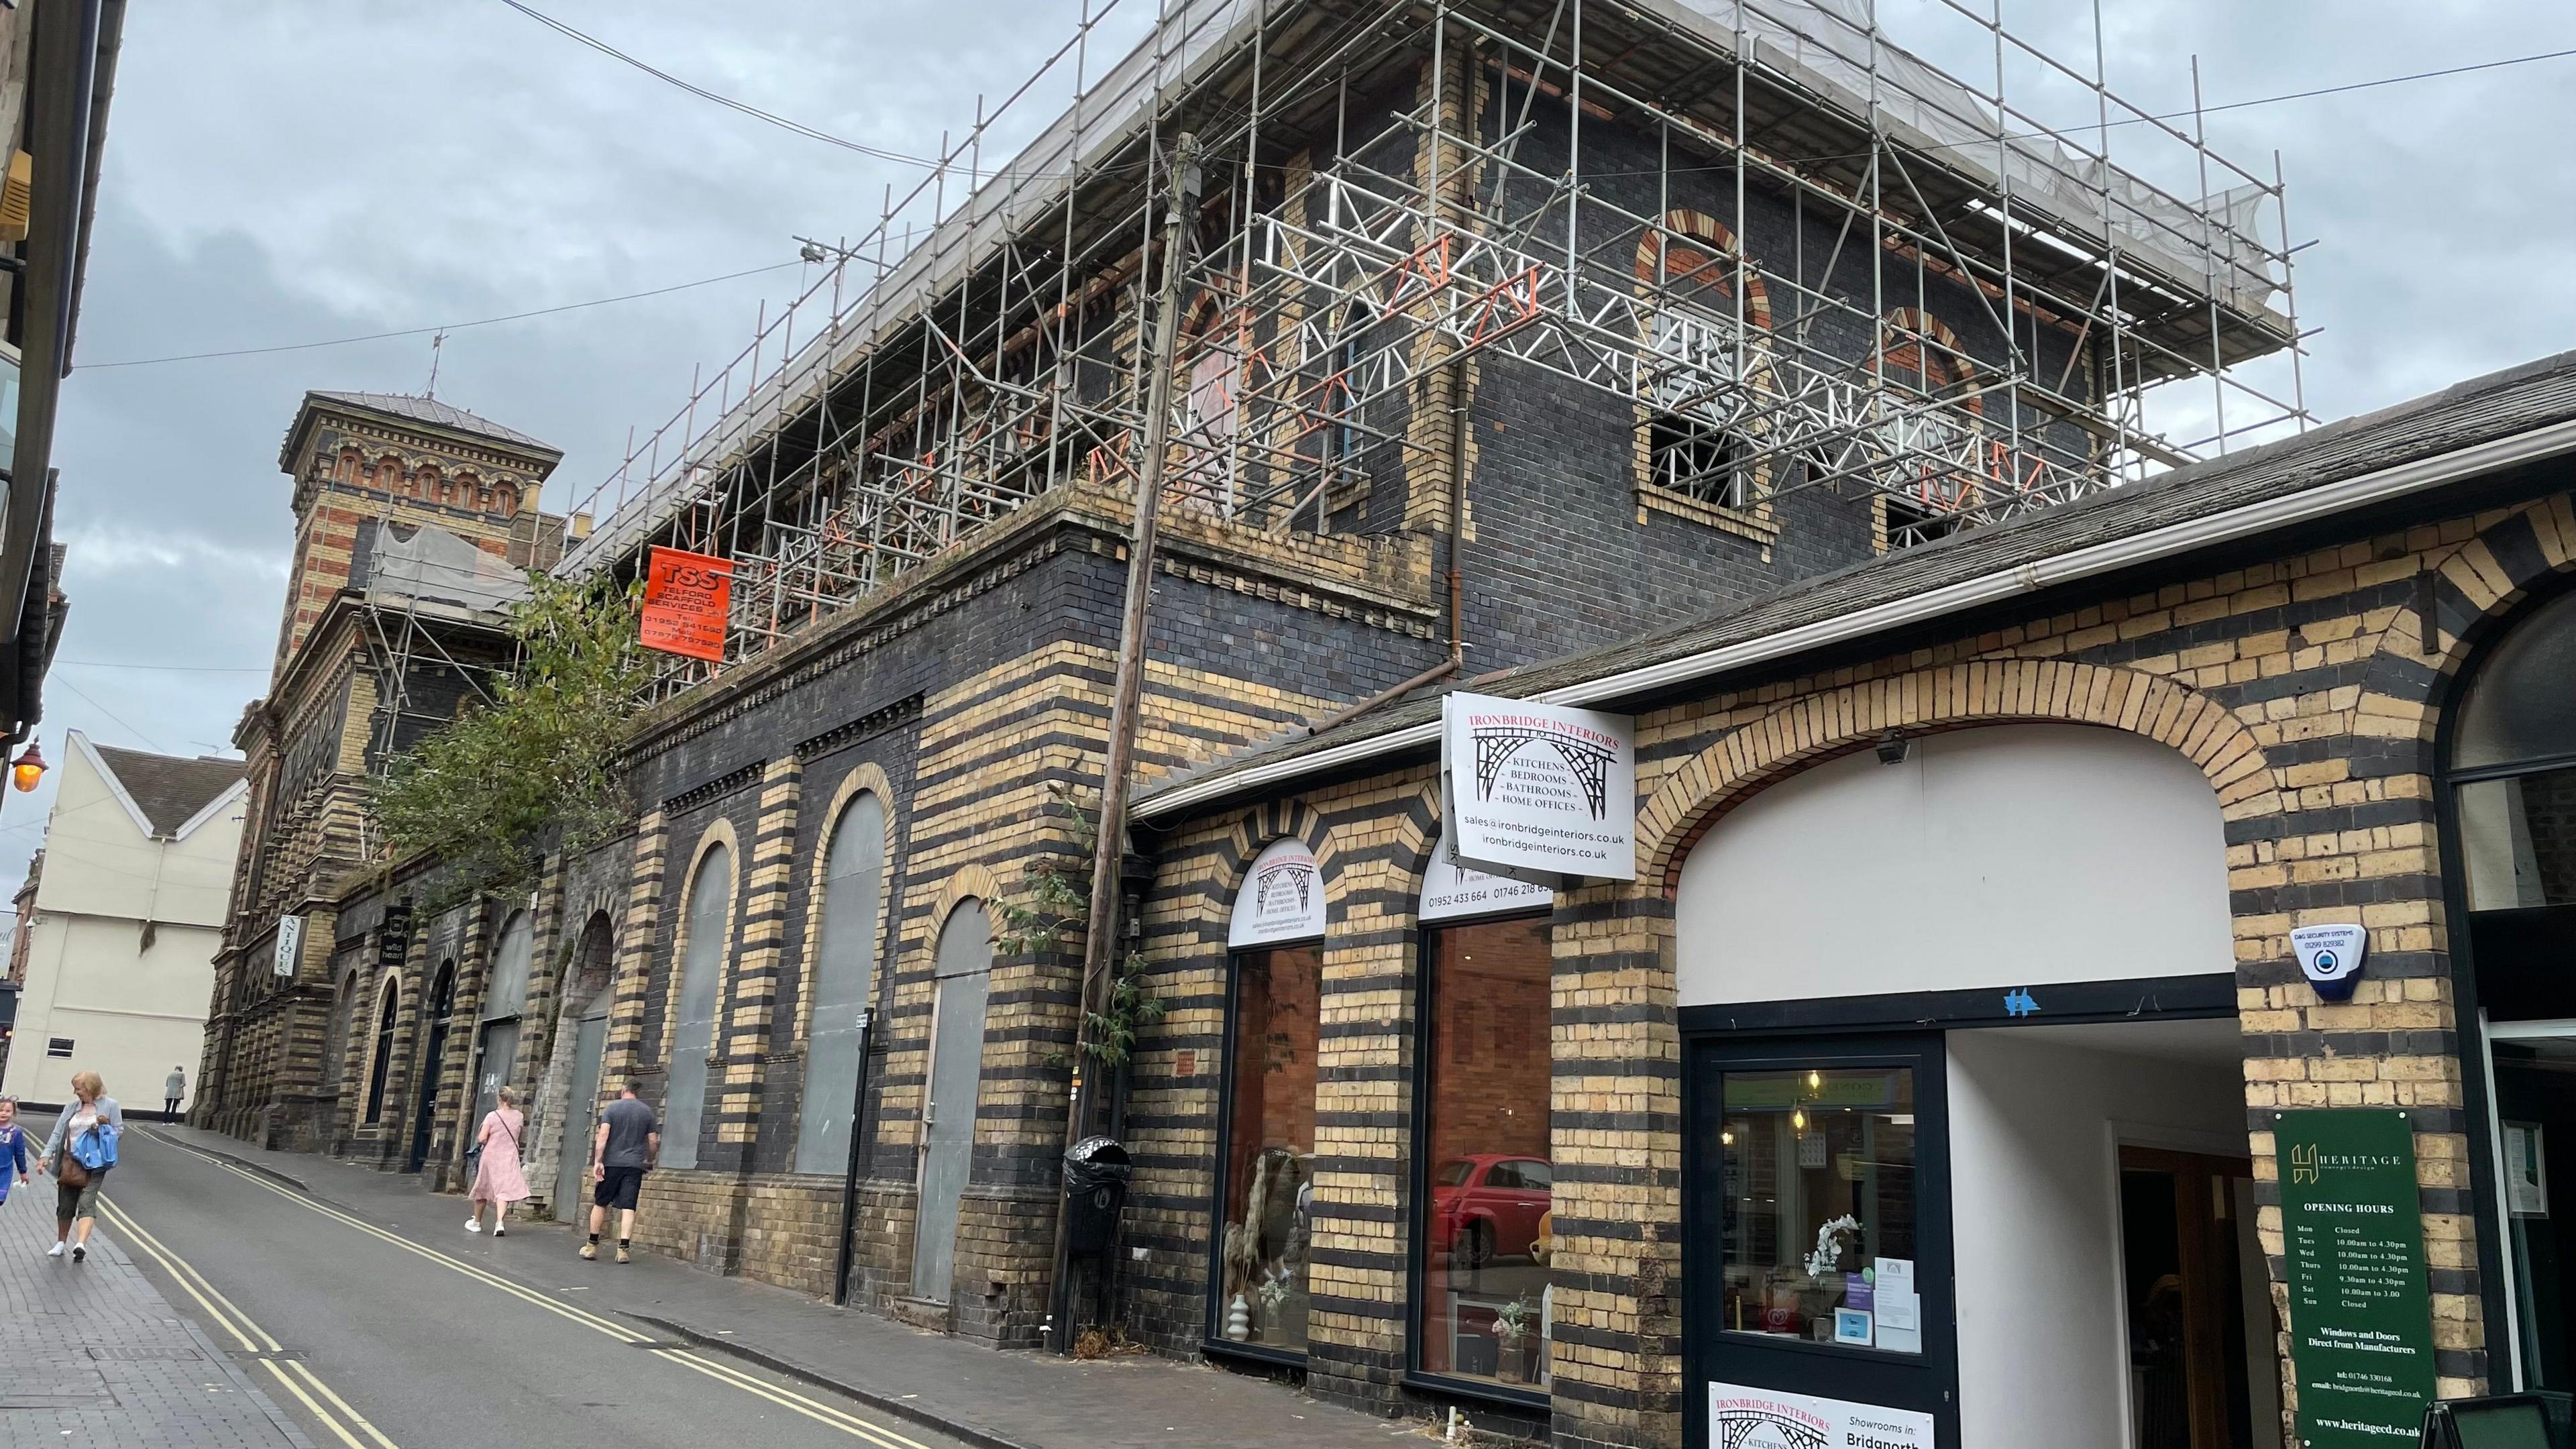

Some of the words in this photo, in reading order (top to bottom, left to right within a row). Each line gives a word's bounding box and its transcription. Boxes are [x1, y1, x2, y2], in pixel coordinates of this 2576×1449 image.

[660, 562, 719, 590] TSS
[657, 592, 716, 607] SCAFFOLD
[662, 586, 712, 600] TELFORD
[648, 598, 703, 612] SERVICES
[645, 616, 680, 626] 01952
[1469, 715, 1548, 729] IRONBRIDGE
[1552, 720, 1619, 749] INTERIORS
[1513, 757, 1565, 771] KITCHENS
[1511, 771, 1566, 785] BEDROOMS
[1506, 782, 1571, 798] BATHROOMS
[1503, 795, 1532, 806] HOME
[1535, 798, 1576, 812] OFFICES
[1464, 816, 1625, 845] sales@ironbridgeinteriors.co.uk
[1483, 835, 1607, 859] ironbridgeinteriors.co.uk
[1256, 857, 1287, 871] IRONBRIDGE
[1288, 855, 1315, 864] INTERIORS
[1273, 881, 1293, 890] KITCHENS
[1271, 890, 1293, 898] BEDROOMS
[1429, 895, 1452, 908] 01952
[1454, 893, 1469, 904] 433
[1471, 891, 1487, 902] 664
[1494, 885, 1519, 898] 01746
[1521, 883, 1536, 895] 218
[1269, 898, 1295, 906] BATHROOMS
[279, 918, 295, 974] ANTIQUES
[386, 943, 402, 951] wild
[382, 950, 403, 959] heart
[2320, 1155, 2401, 1165] HERITAGE
[2304, 1203, 2353, 1213] OPENING
[2356, 1203, 2394, 1214] HOURS
[2337, 1239, 2367, 1247] 10.00am
[2379, 1241, 2406, 1249] 4.30pm
[2338, 1251, 2368, 1259] 10.00am
[2380, 1253, 2408, 1261] 4.30pm
[2339, 1263, 2369, 1271] 10.00am
[2381, 1265, 2409, 1273] 4.30pm
[2339, 1275, 2366, 1284] 9.30am
[2378, 1278, 2406, 1286] 4.30pm
[2341, 1288, 2371, 1296] 10.00am
[2341, 1300, 2367, 1308] Closed
[2320, 1327, 2357, 1338] Windows
[2359, 1331, 2374, 1339] and
[2376, 1332, 2400, 1342] Doors
[2308, 1338, 2332, 1348] Direct
[2334, 1340, 2353, 1350] from
[2355, 1342, 2416, 1354] Manufacturers
[2349, 1372, 2368, 1380] 01746
[2369, 1374, 2392, 1383] 330168
[2332, 1383, 2421, 1398] bridgnorth@heritagecd.co.uk
[1717, 1399, 1774, 1411] IRONBRIDGE
[1777, 1403, 1831, 1432] INTERIORS
[1849, 1416, 1902, 1434] Showrooms
[1904, 1425, 1917, 1436] in:
[2316, 1417, 2420, 1438] www.heritagecd.co.uk
[1748, 1438, 1788, 1449] KITCHENS
